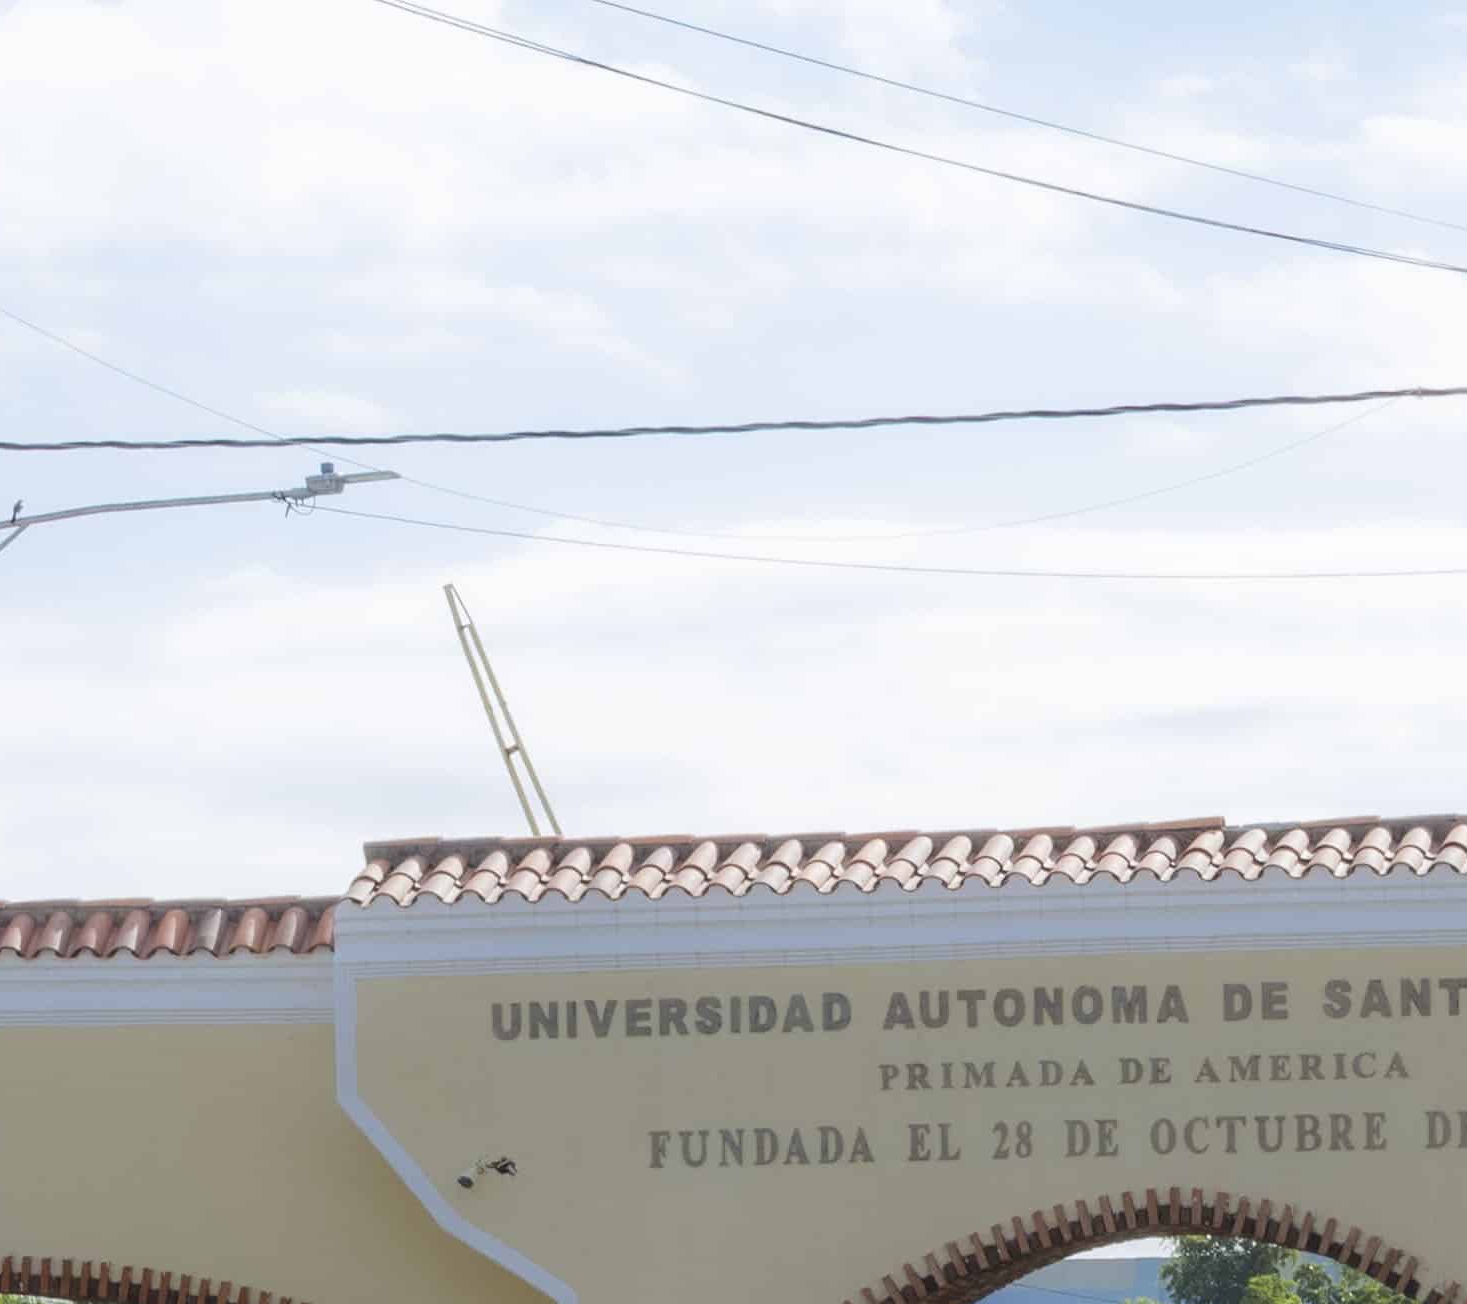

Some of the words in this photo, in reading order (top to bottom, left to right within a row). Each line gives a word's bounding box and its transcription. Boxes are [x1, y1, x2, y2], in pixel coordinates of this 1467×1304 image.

[492, 992, 852, 1041] UNIVERSIDAD
[883, 985, 1190, 1031] AUTONOMA
[1222, 981, 1289, 1022] DE
[878, 1058, 1096, 1091] PRIMADA
[1118, 1055, 1172, 1085] DE
[1194, 1050, 1411, 1083] AMERICA
[648, 1124, 875, 1168] FUNDADA
[907, 1121, 961, 1162] EL
[992, 1120, 1035, 1159] 28
[1065, 1117, 1120, 1158] DE
[1149, 1111, 1388, 1155] OCTUBRE
